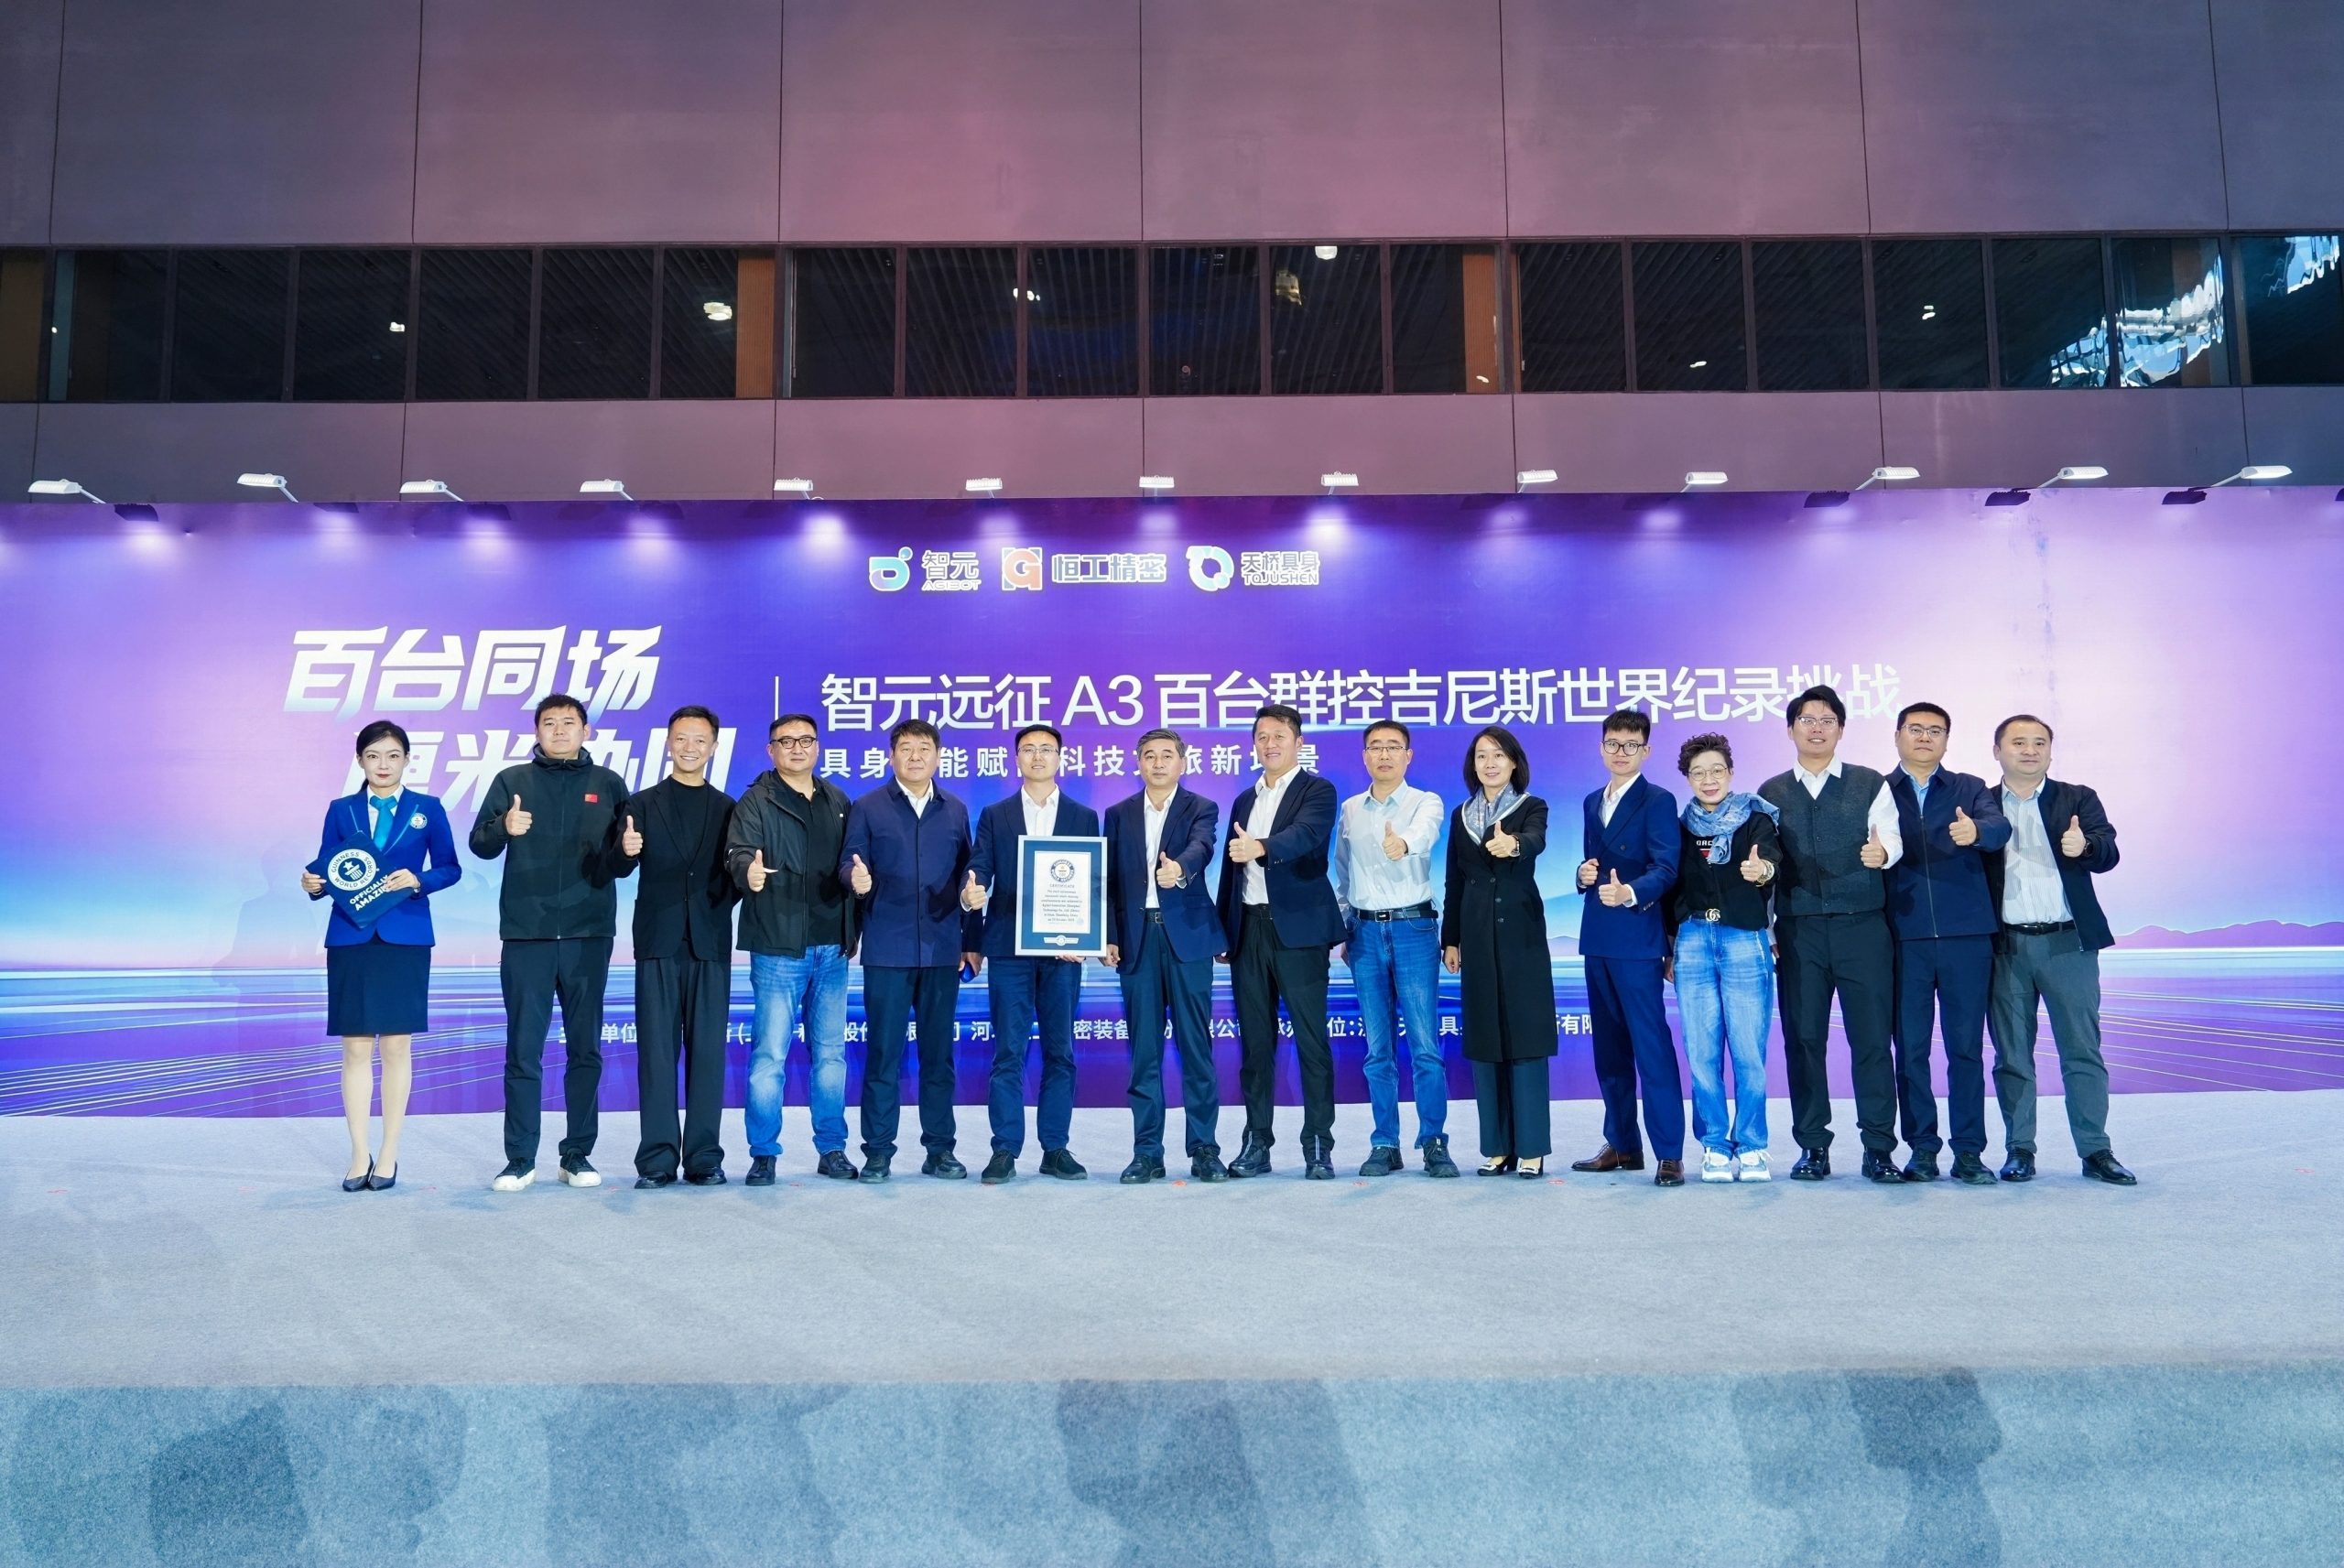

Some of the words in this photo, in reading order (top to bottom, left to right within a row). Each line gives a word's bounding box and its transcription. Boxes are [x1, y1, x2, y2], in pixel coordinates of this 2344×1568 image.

[922, 550, 979, 579] 智元
[1052, 554, 1167, 583] 恒工精密
[1241, 551, 1320, 572] 天桥具身
[282, 625, 662, 723] 百台同场
[822, 673, 1052, 730] 智元远征
[1061, 675, 1144, 727] A3
[331, 852, 360, 872] GUINNESS
[334, 877, 358, 888] WORLD
[355, 886, 385, 911] AMAZI
